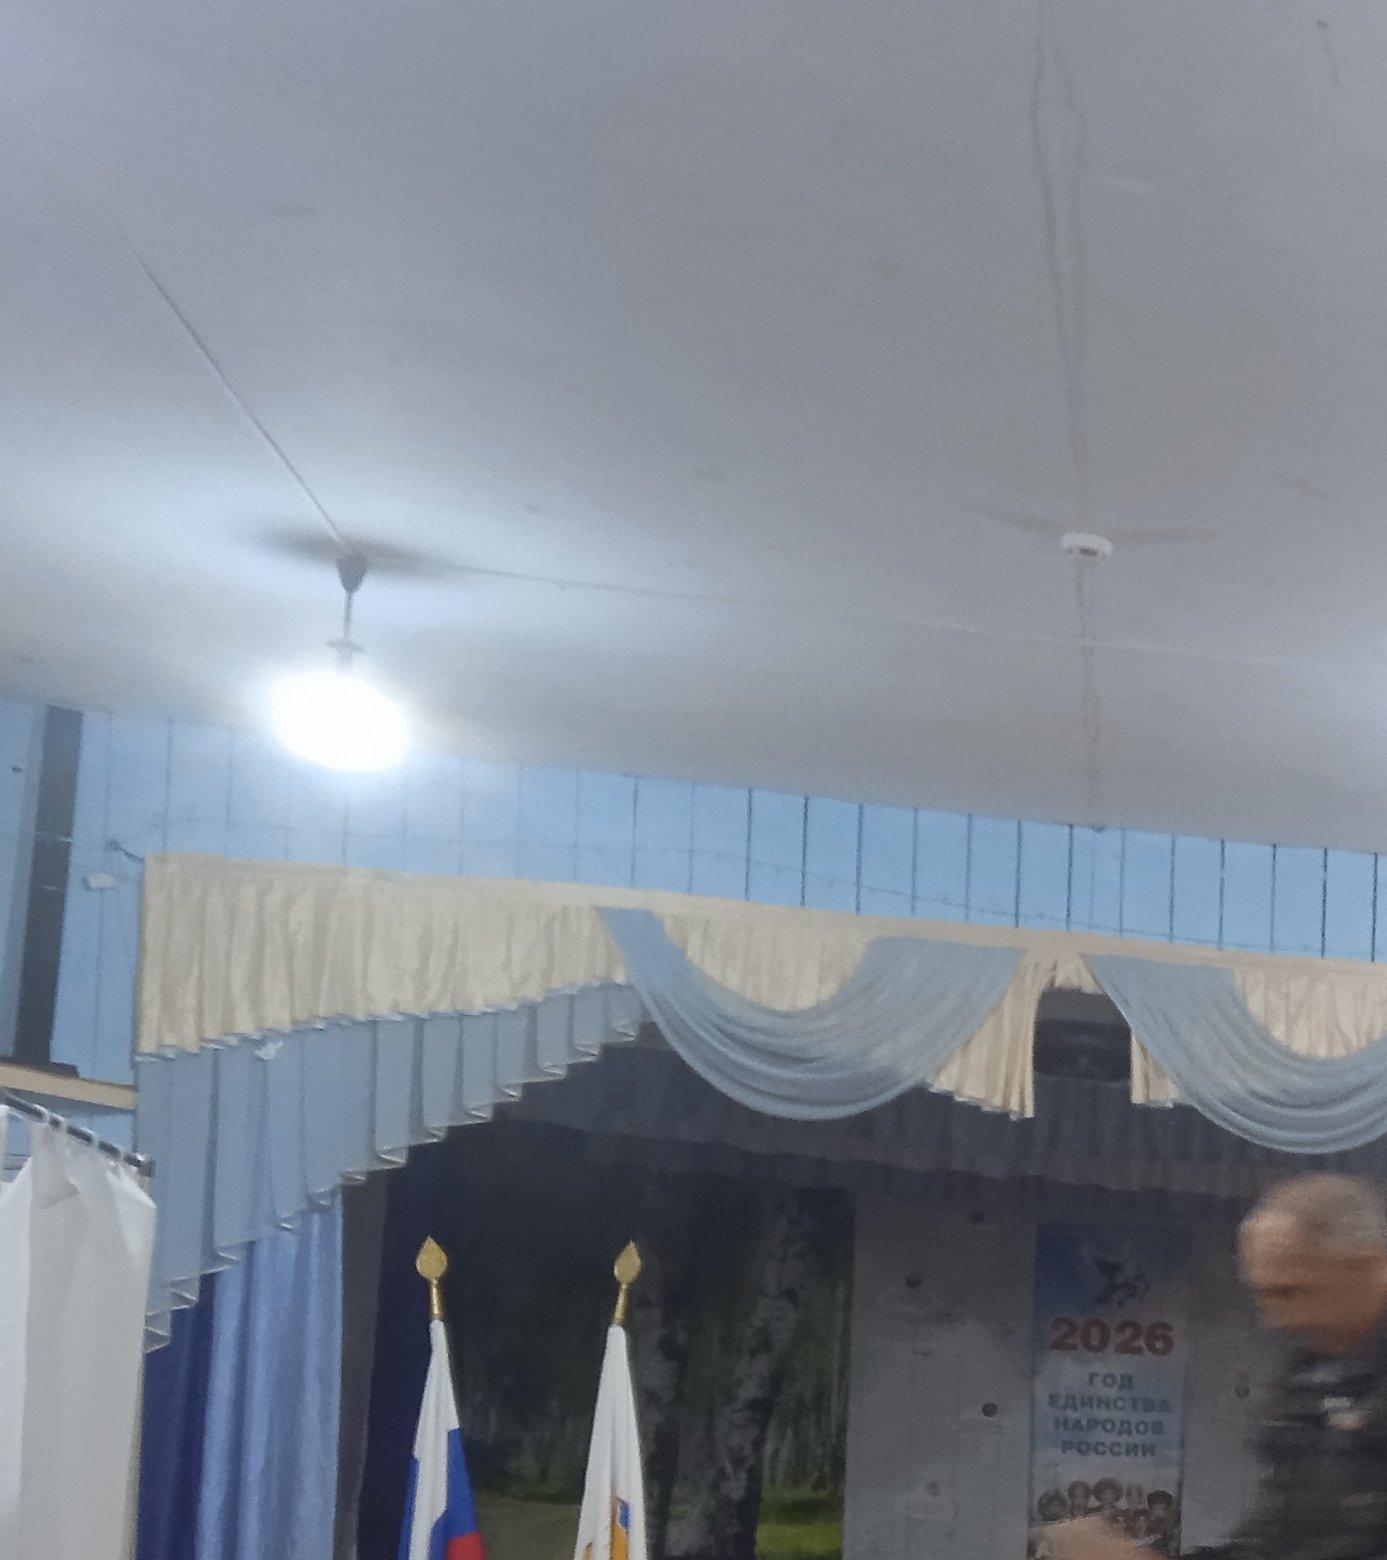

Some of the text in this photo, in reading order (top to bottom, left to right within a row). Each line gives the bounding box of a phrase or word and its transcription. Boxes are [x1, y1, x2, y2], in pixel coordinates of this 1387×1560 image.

[1049, 1316, 1175, 1356] 2026
[1088, 1371, 1134, 1391] ГОД
[1048, 1393, 1172, 1413] ЕДИНСТВА
[1054, 1416, 1165, 1436] НАРОДОВ
[1061, 1440, 1156, 1457] РОССИИ
